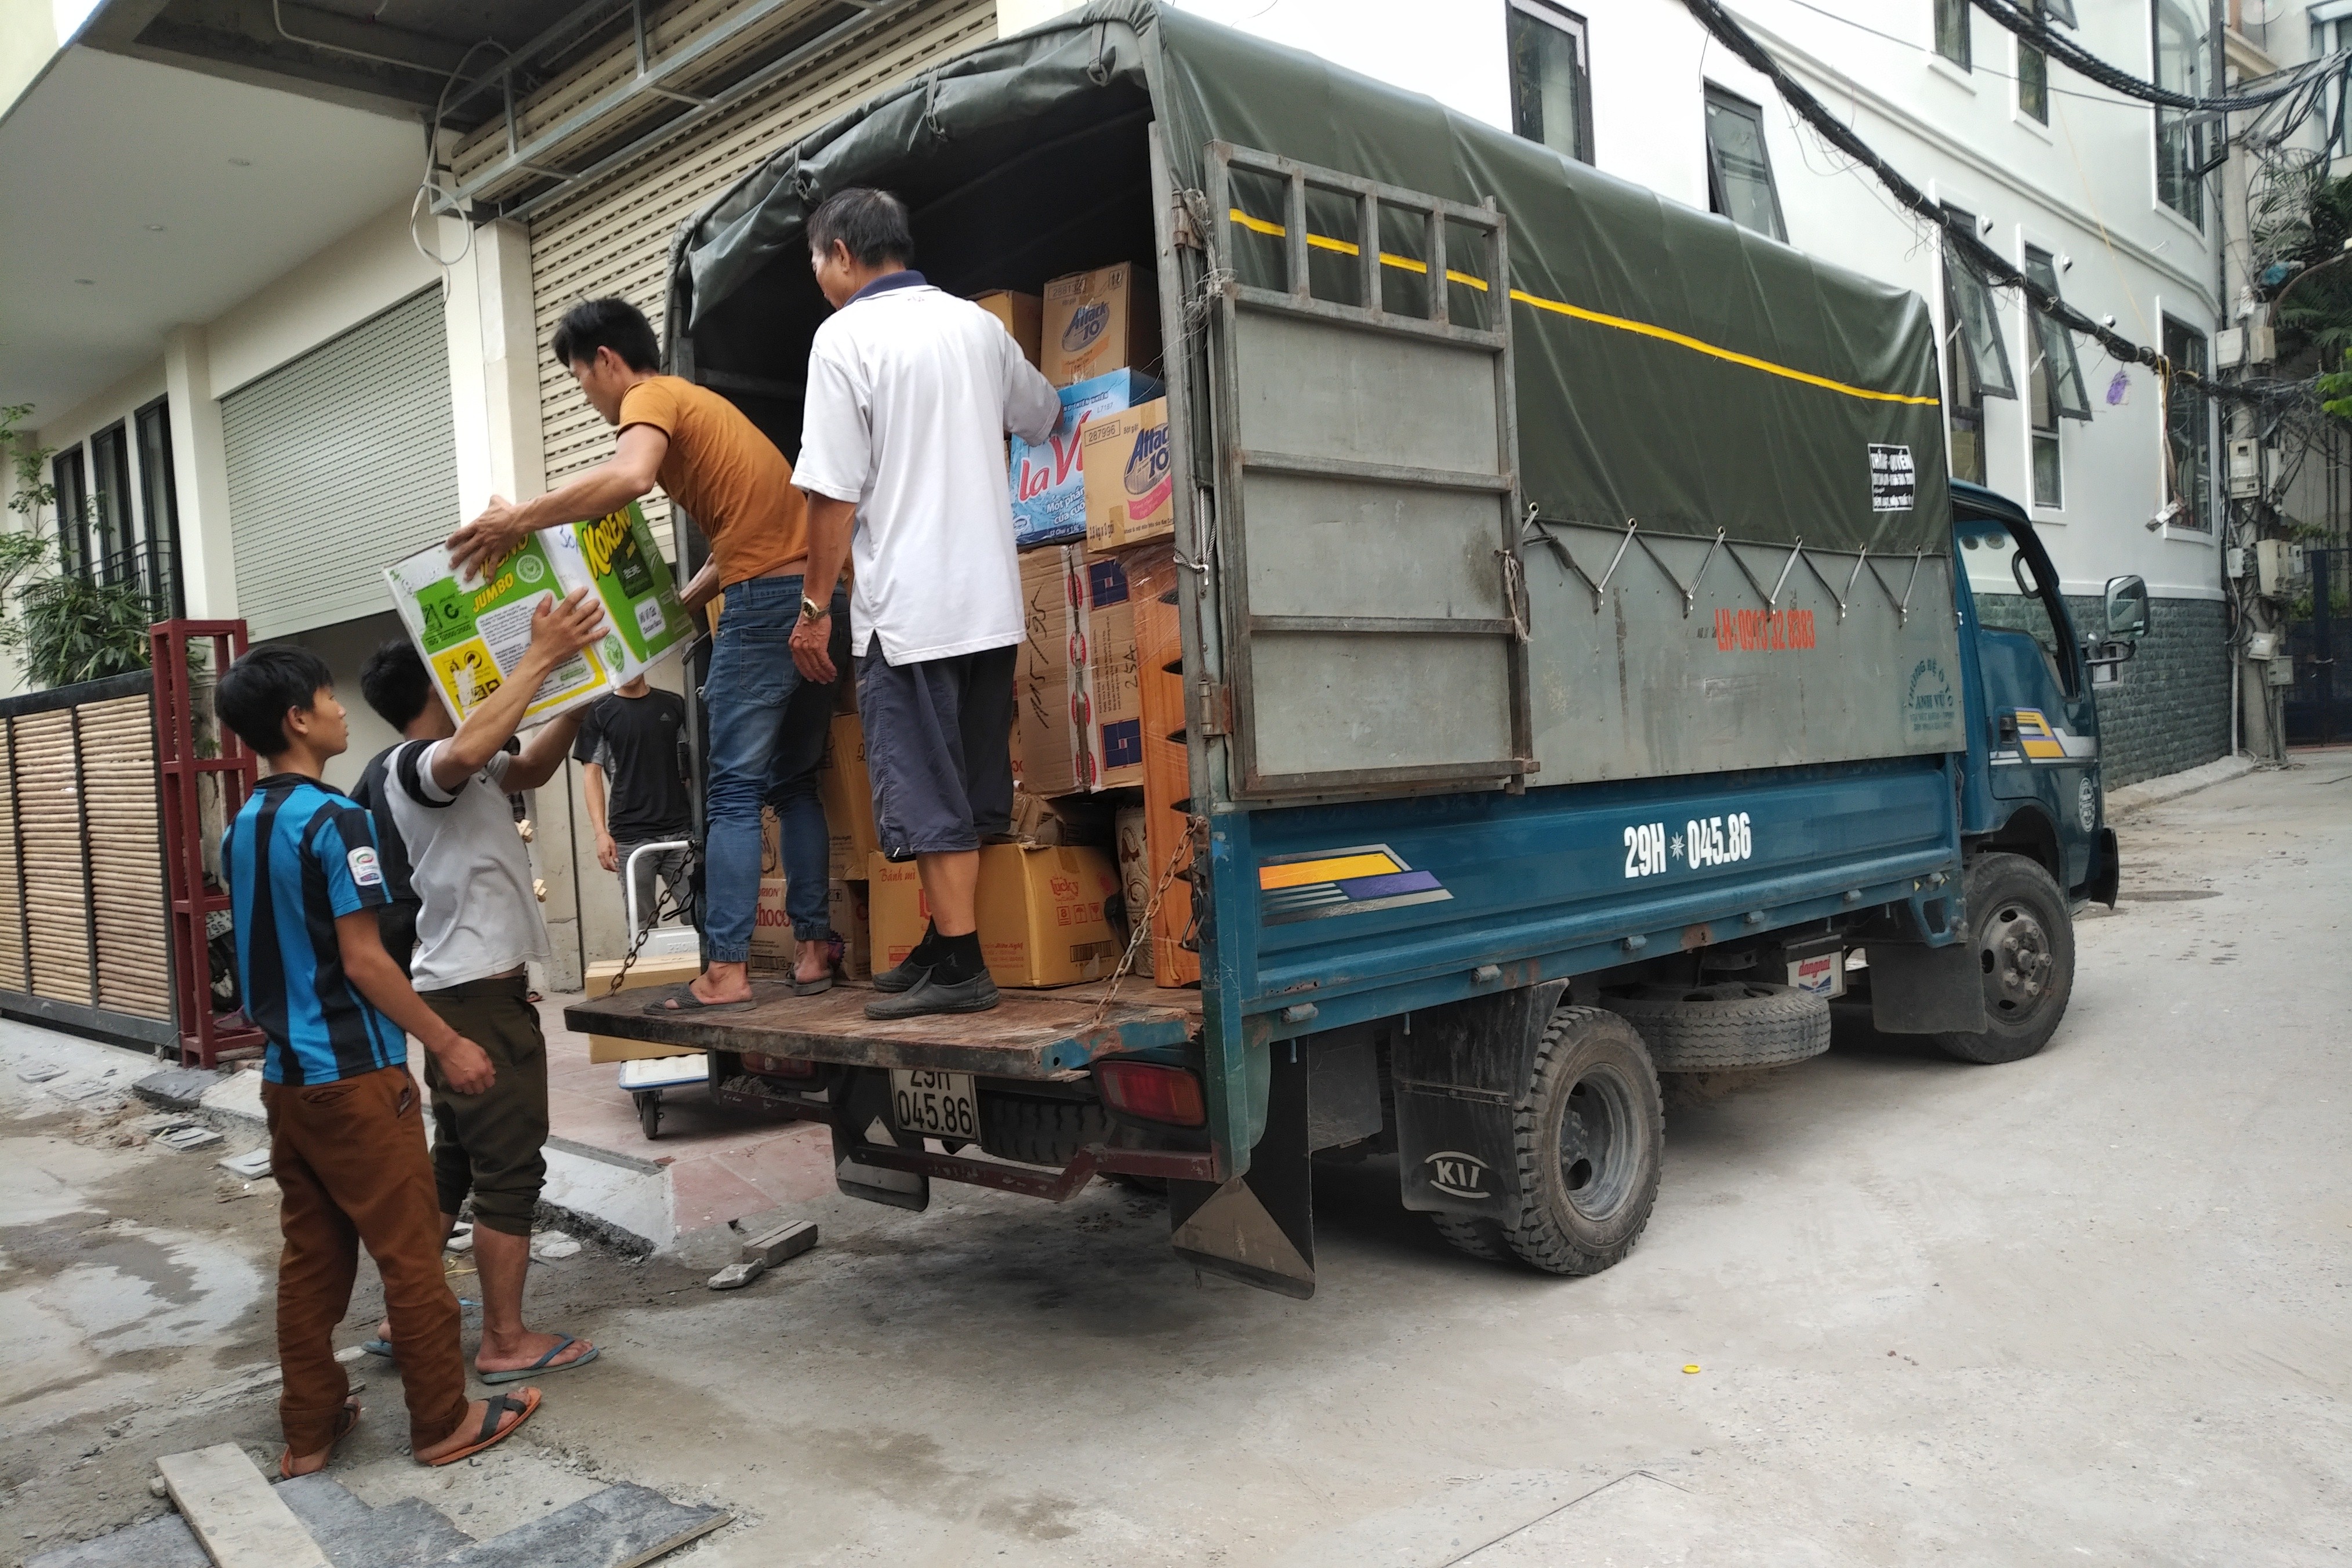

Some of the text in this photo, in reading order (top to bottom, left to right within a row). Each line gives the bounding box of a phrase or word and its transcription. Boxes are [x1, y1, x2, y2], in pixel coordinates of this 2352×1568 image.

[1065, 301, 1110, 339] Attack
[1083, 320, 1100, 341] 10
[1088, 425, 1116, 442] 287996
[1127, 425, 1169, 475] Attac
[1148, 447, 1169, 479] 10
[473, 572, 514, 614] JUMBO
[1624, 811, 1752, 879] 29H 045.86
[879, 866, 903, 882] Bánh
[756, 902, 791, 927] hoco
[897, 1090, 972, 1135] 045.86
